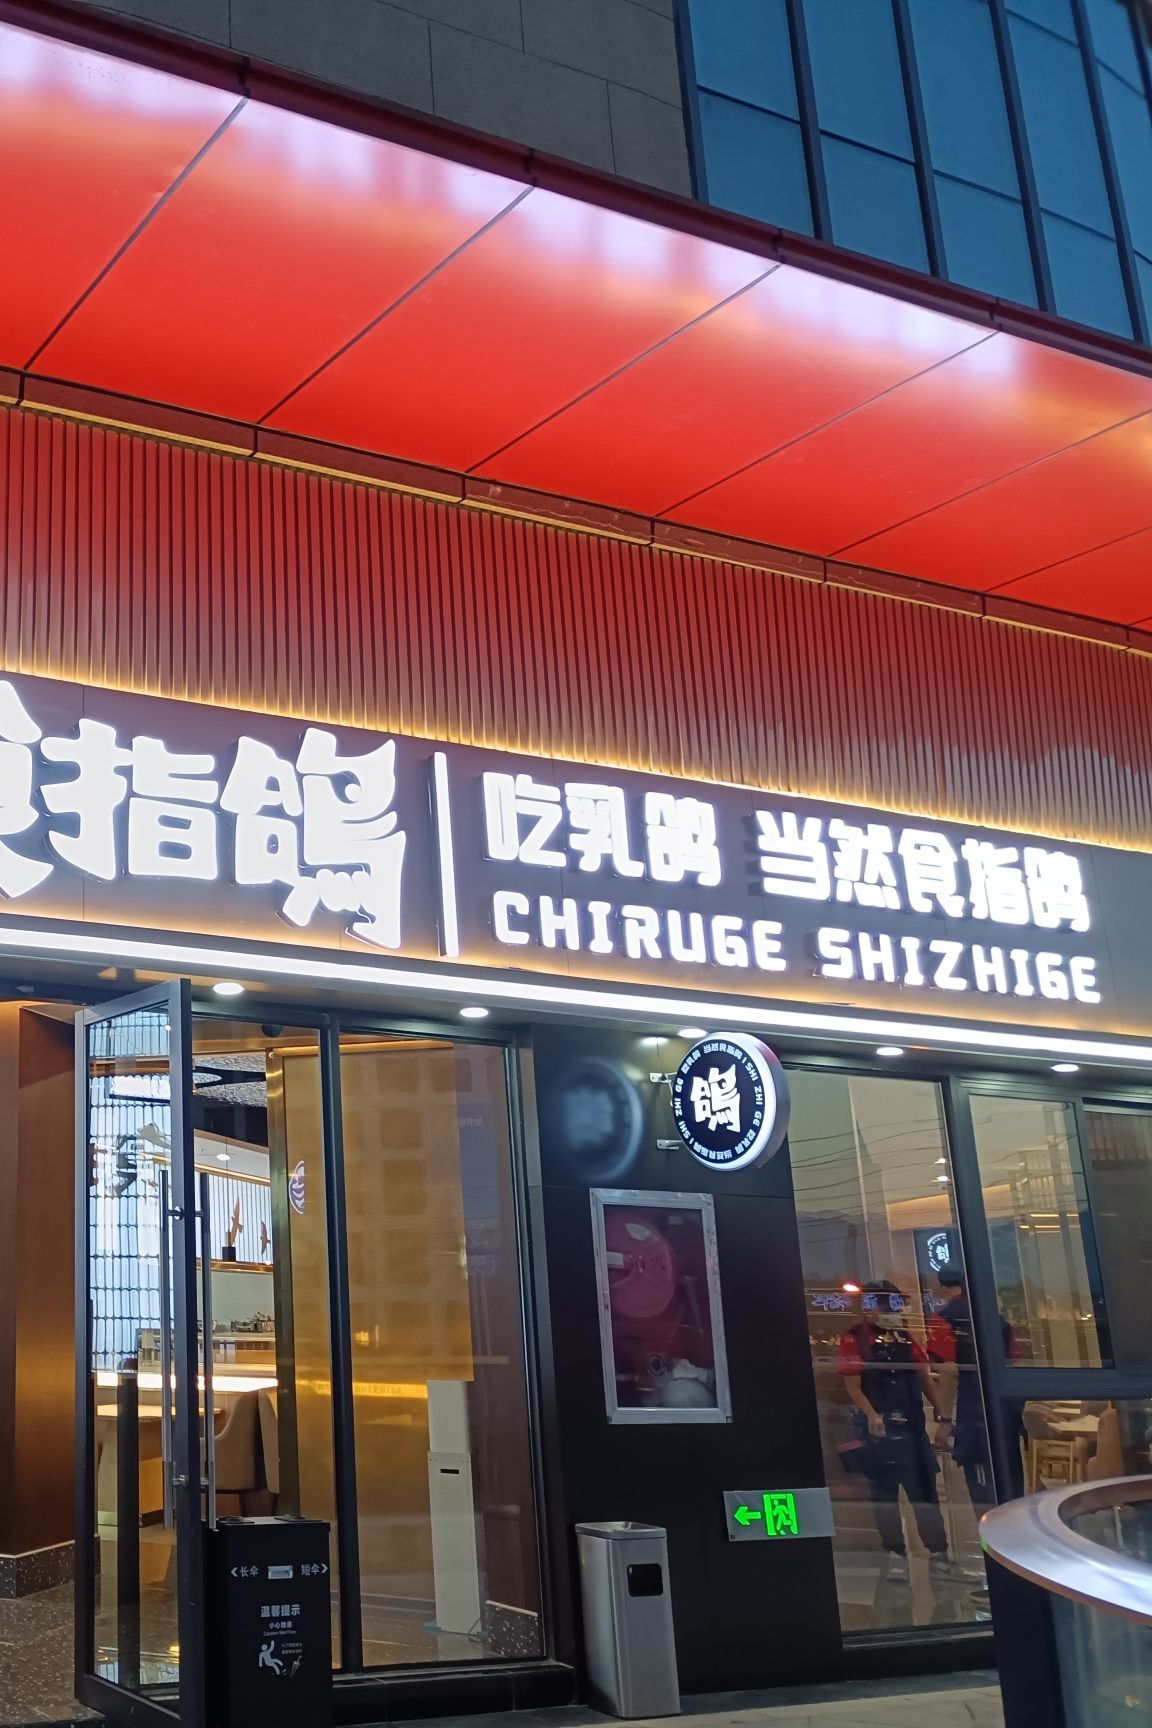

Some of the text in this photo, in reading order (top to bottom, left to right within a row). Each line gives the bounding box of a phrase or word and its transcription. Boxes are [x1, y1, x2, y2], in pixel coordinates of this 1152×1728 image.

[482, 771, 1091, 932] 吃乳鸽 当然食指鸽
[492, 890, 1102, 1004] CHIRUGE SHIZHIGE
[690, 1063, 741, 1133] 鸽
[240, 1565, 259, 1577] 长伞
